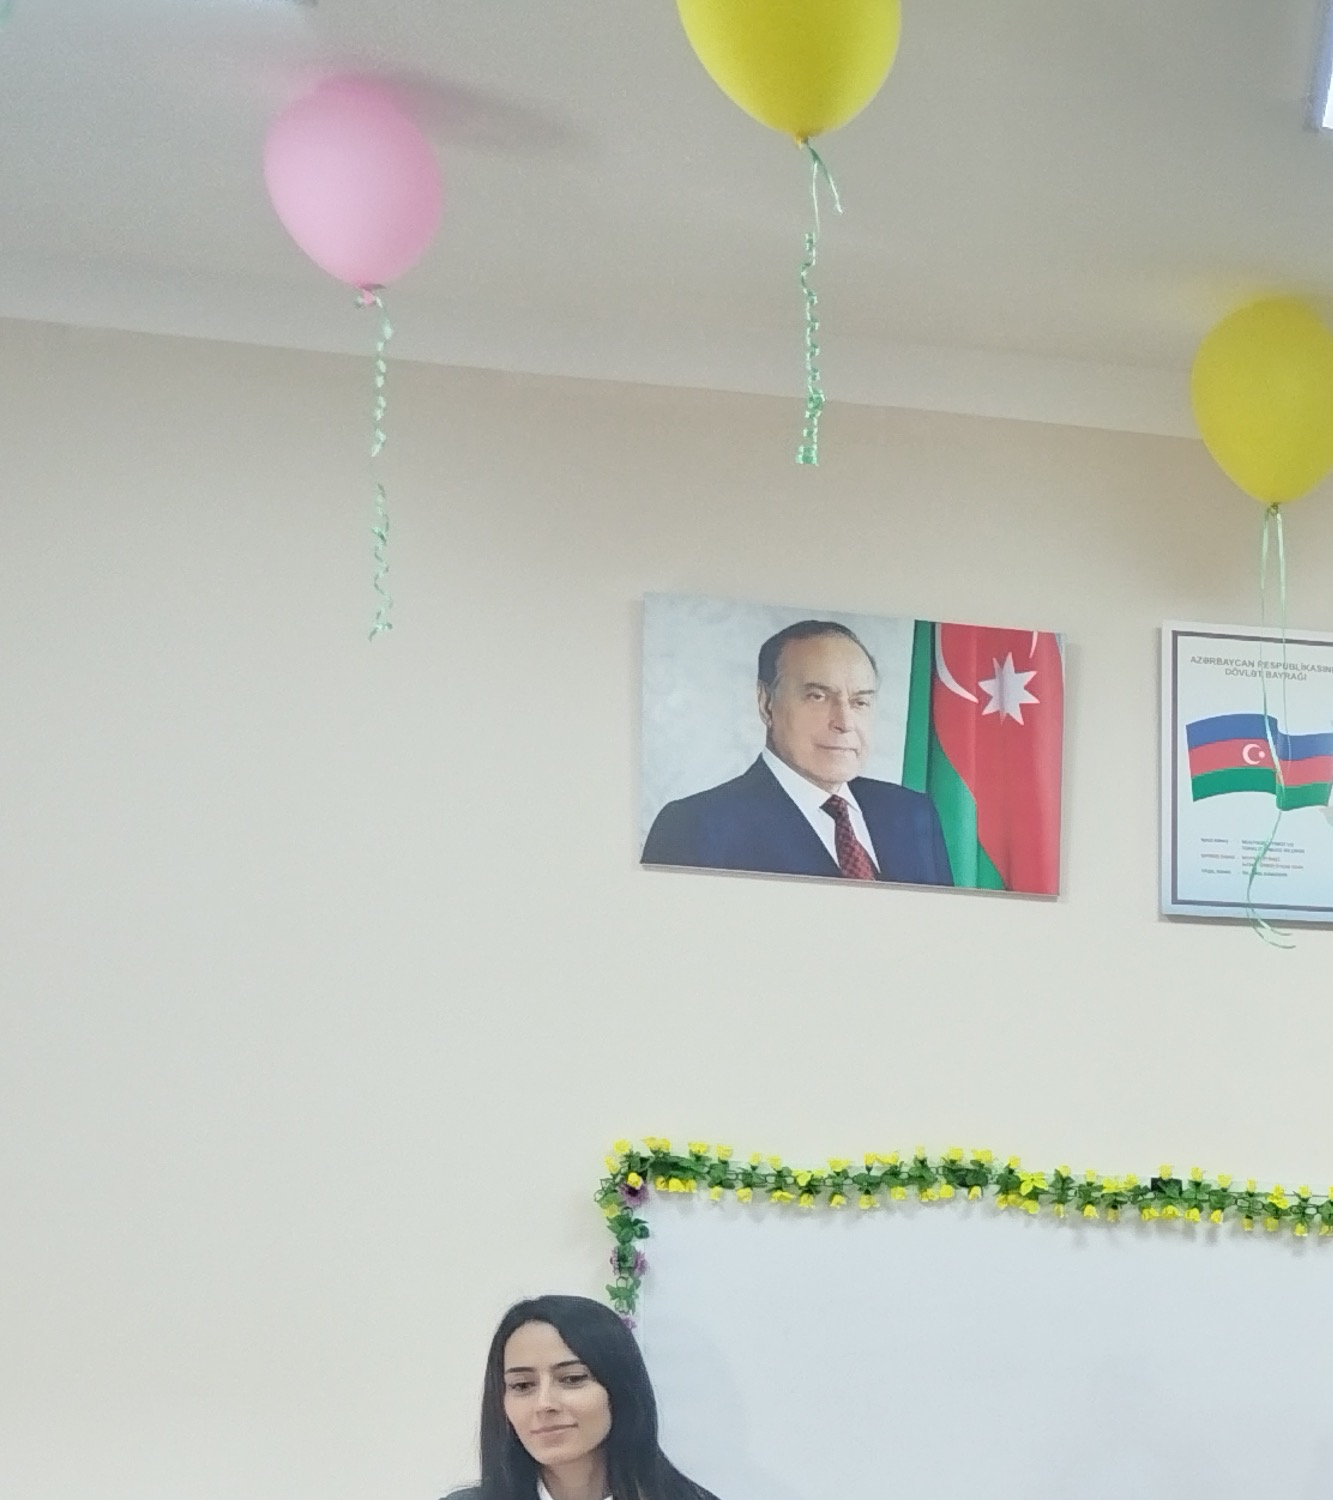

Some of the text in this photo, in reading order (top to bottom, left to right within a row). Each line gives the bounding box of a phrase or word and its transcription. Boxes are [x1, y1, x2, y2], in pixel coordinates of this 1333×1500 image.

[1190, 655, 1255, 668] AZƏRBAYCAN
[1224, 667, 1307, 681] DÖVLƏT BAYRAĞI
